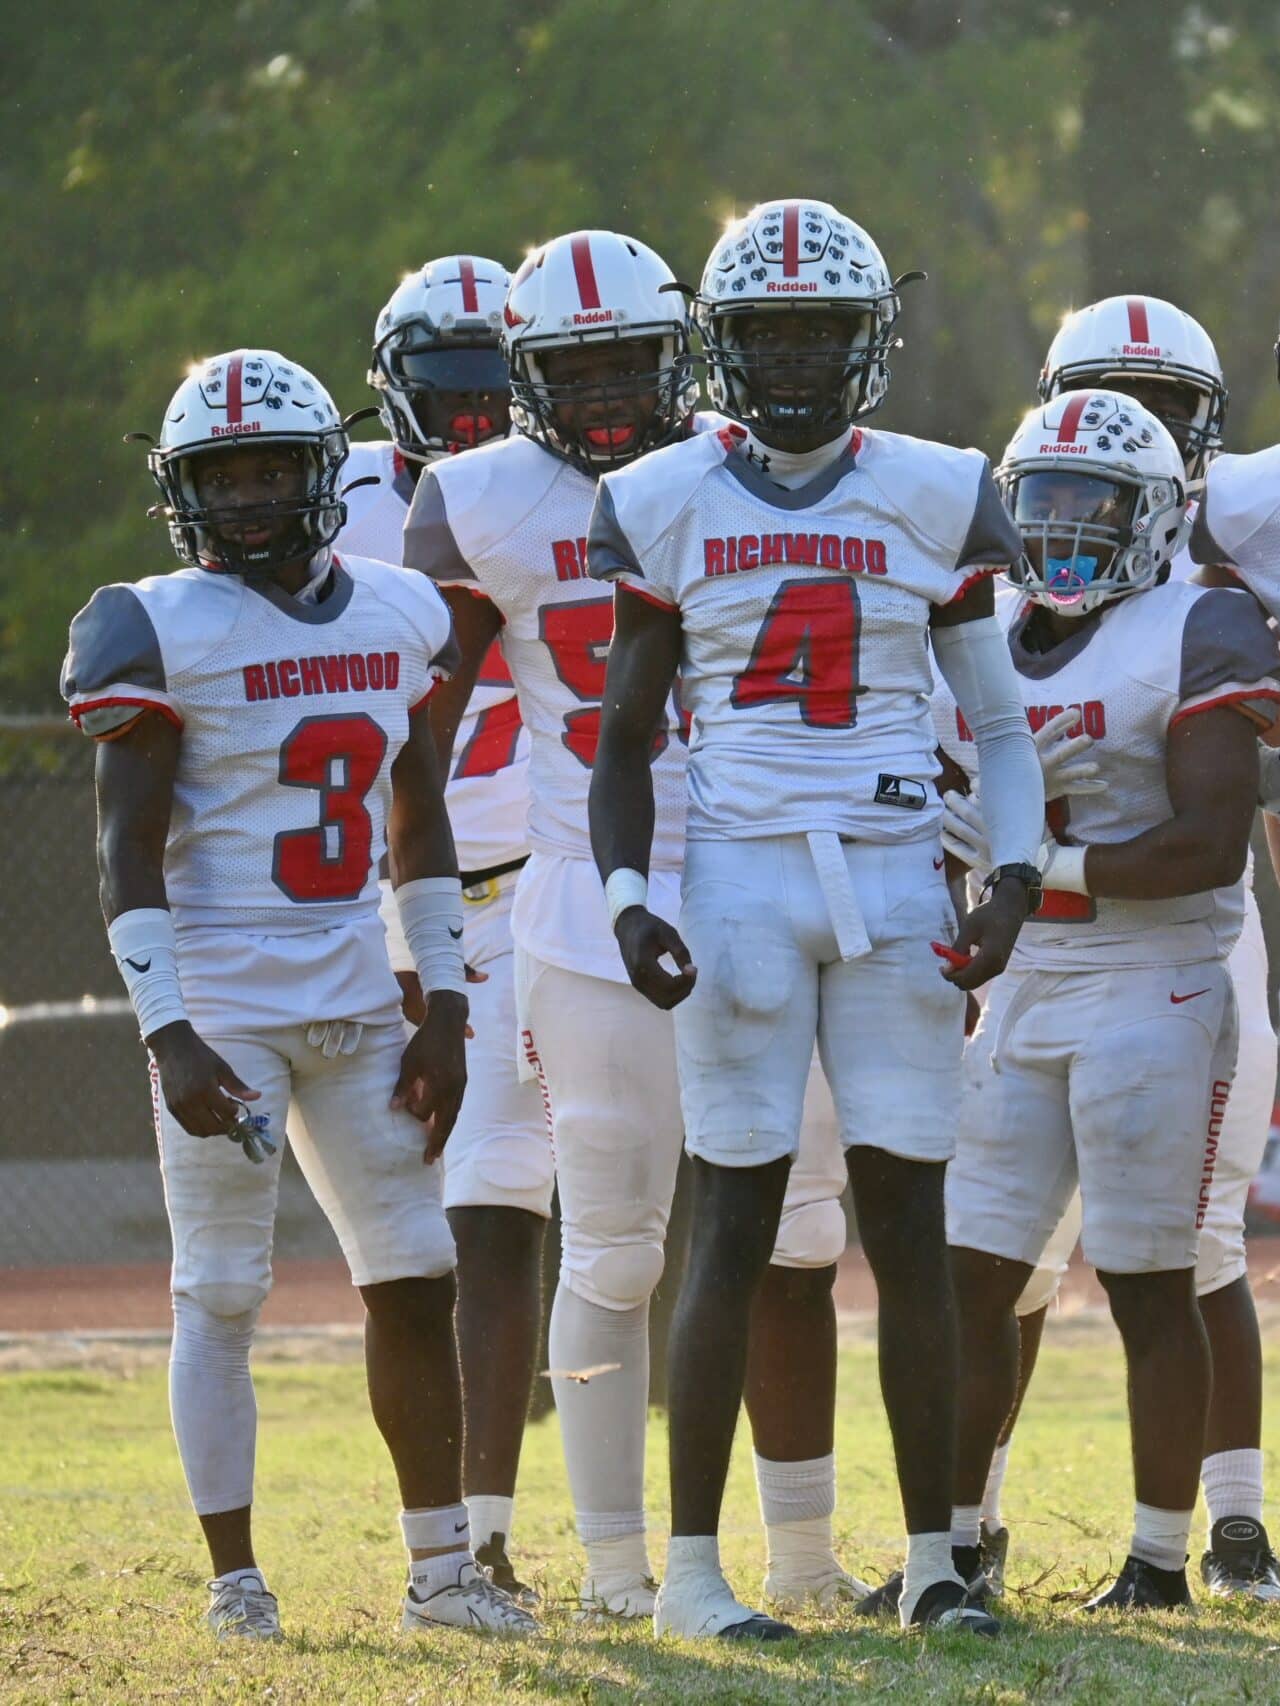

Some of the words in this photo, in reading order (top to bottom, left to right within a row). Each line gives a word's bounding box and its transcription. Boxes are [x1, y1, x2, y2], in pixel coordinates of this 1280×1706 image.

[766, 281, 818, 293] Riddell
[573, 309, 613, 325] Riddell
[1122, 344, 1160, 357] Riddell
[211, 421, 261, 436] Riddell
[1039, 444, 1088, 455] Riddell
[703, 533, 888, 577] RICHWOOD
[729, 575, 869, 729] 4
[243, 651, 400, 702] RICHWOOD
[271, 712, 388, 904] 3
